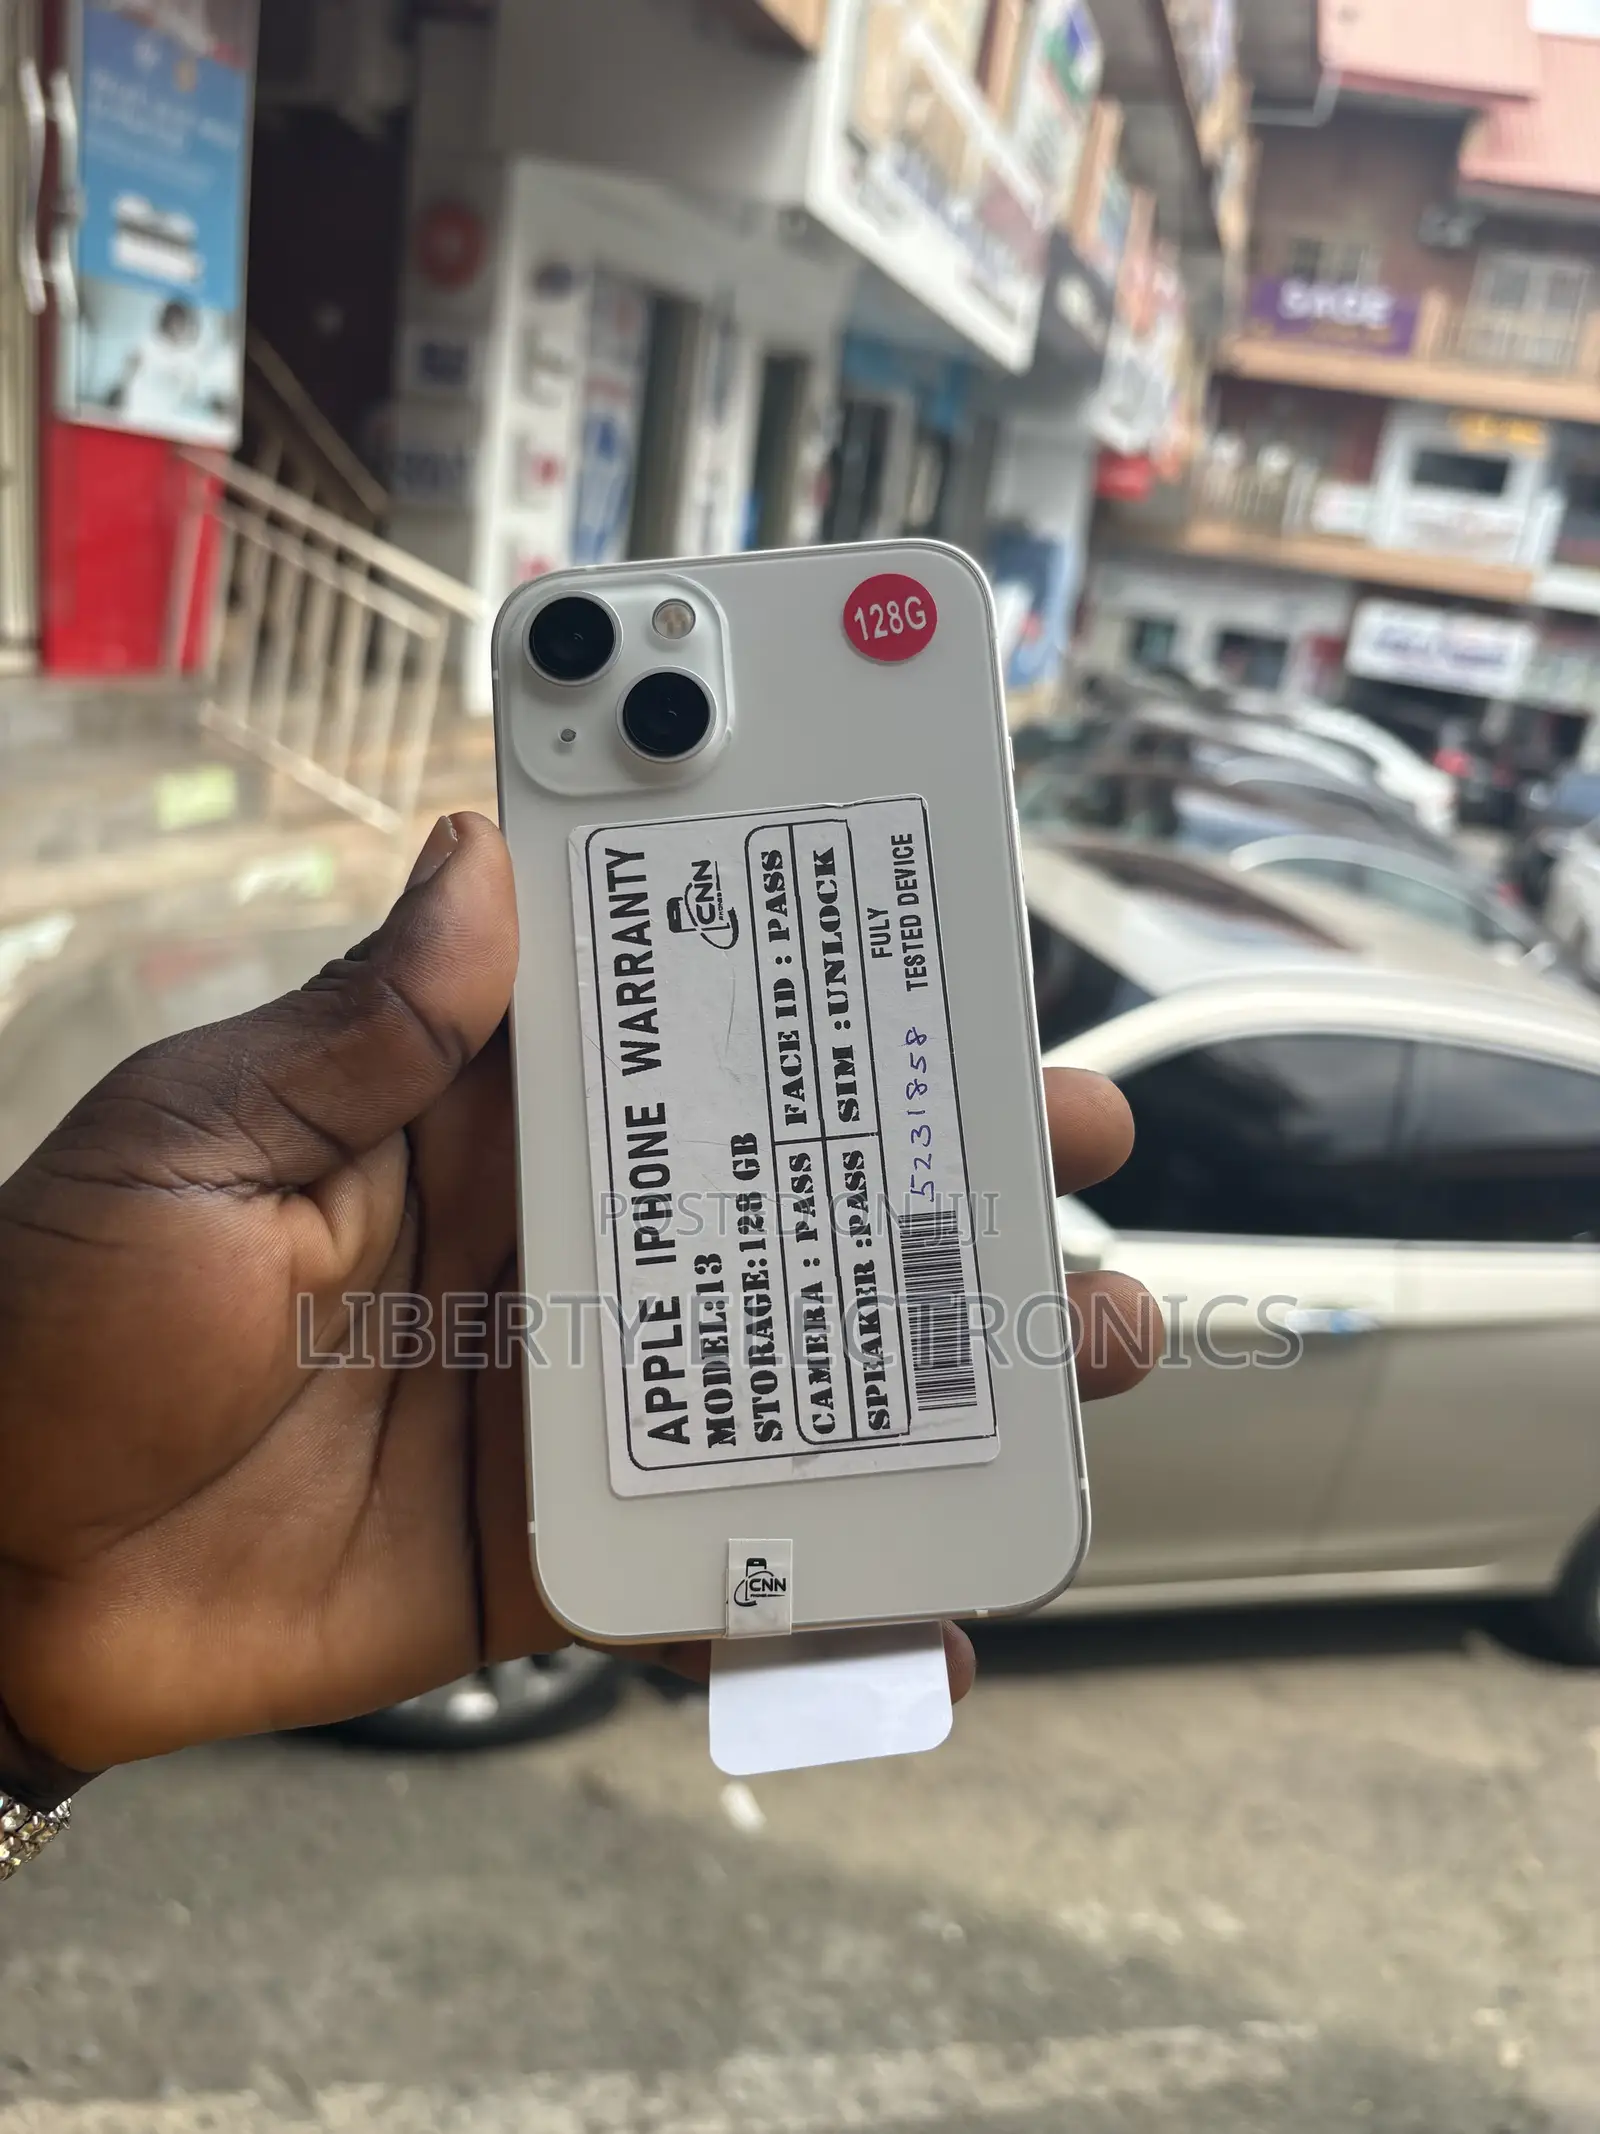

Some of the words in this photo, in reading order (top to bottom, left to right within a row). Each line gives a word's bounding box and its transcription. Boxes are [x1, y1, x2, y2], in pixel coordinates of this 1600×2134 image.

[853, 596, 927, 641] 128G
[691, 859, 717, 925] CNN
[761, 849, 791, 942] PASS
[890, 832, 920, 906] DEVICE
[604, 847, 662, 1077] WARRANTY
[866, 906, 893, 959] FULY
[899, 913, 929, 992] TESTED
[773, 977, 798, 1018] ID
[777, 1030, 808, 1127] FACE
[831, 1044, 861, 1124] SIM
[905, 1026, 936, 1202] 5231858
[624, 1102, 677, 1266] IPHONE
[730, 1132, 761, 1181] GB
[788, 1151, 820, 1243] PASS
[693, 1252, 737, 1448] MODEL:13
[736, 1190, 783, 1443] STORAGE:128
[803, 1280, 836, 1435] CAMERA
[853, 1258, 892, 1431] SPEAKER
[638, 1295, 691, 1445] APPLE
[749, 1577, 787, 1592] CNN
